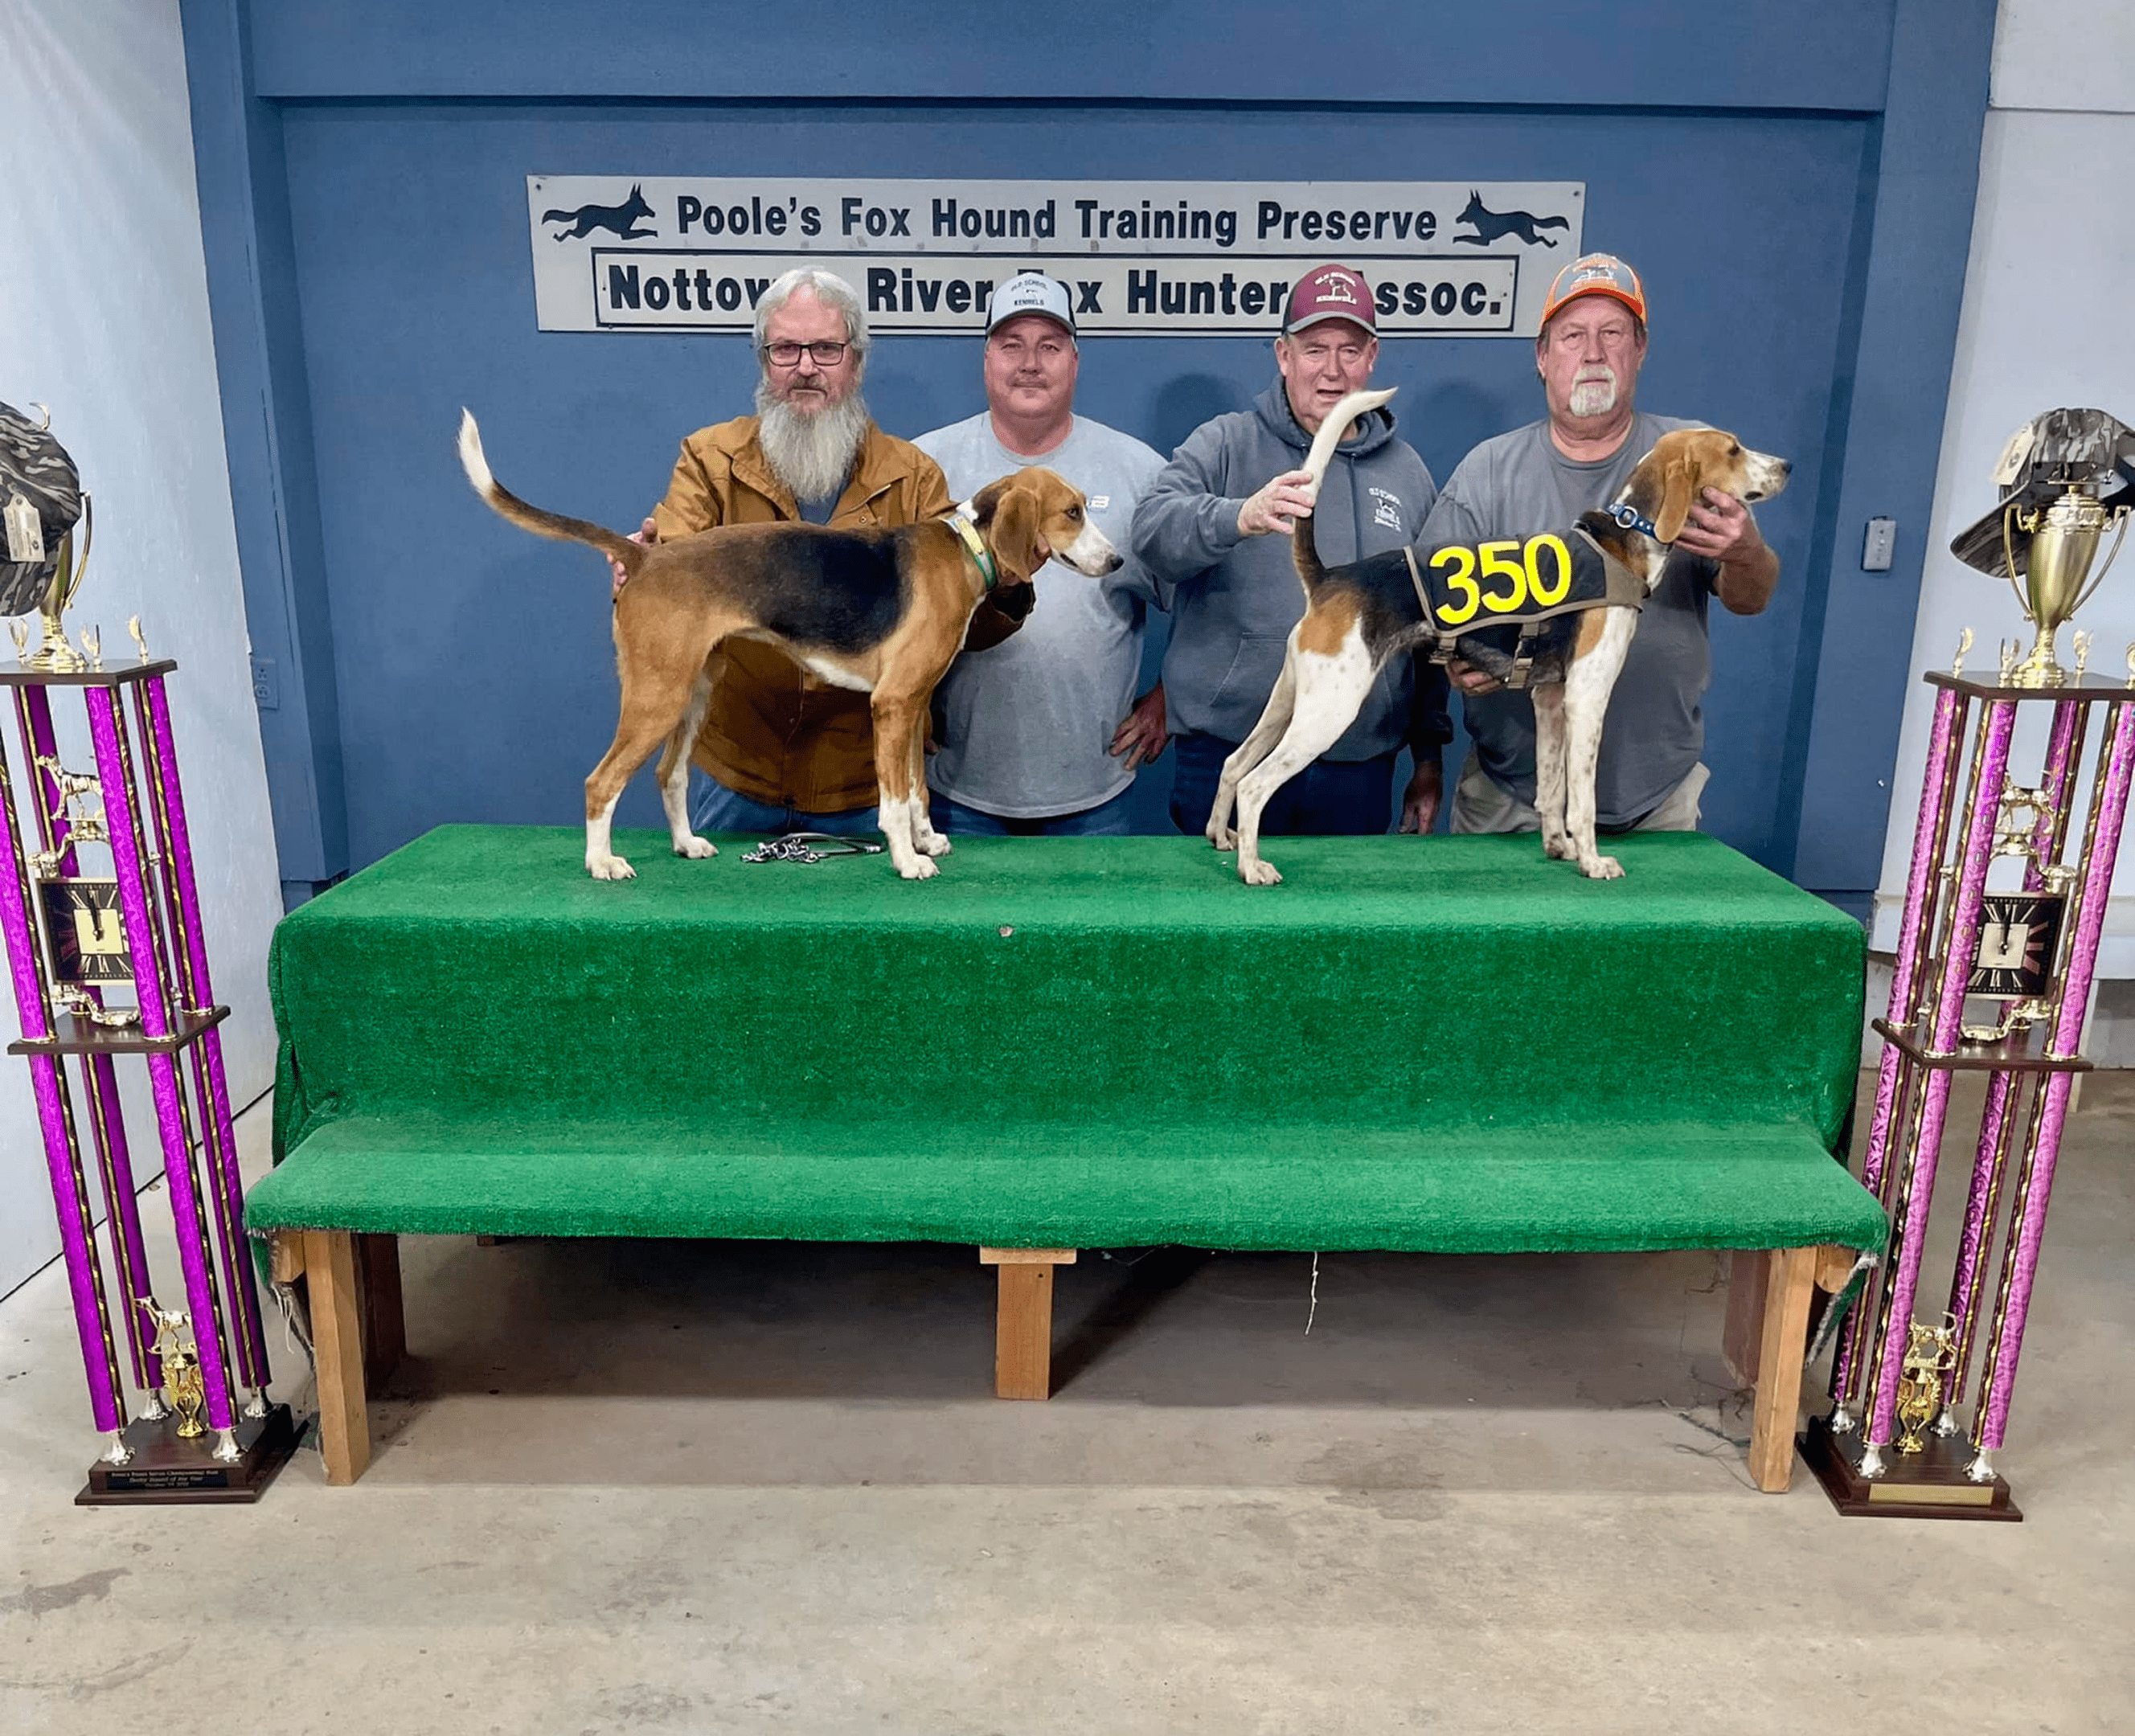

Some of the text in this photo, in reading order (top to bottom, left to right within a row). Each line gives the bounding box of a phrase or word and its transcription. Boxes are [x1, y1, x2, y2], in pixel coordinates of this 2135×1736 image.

[677, 195, 1436, 244] Poole's Fox Hound Training Preserve
[867, 267, 994, 313] River
[1127, 269, 1289, 315] Hunter
[1353, 270, 1501, 316] ssoc.
[1429, 534, 1572, 624] 350
